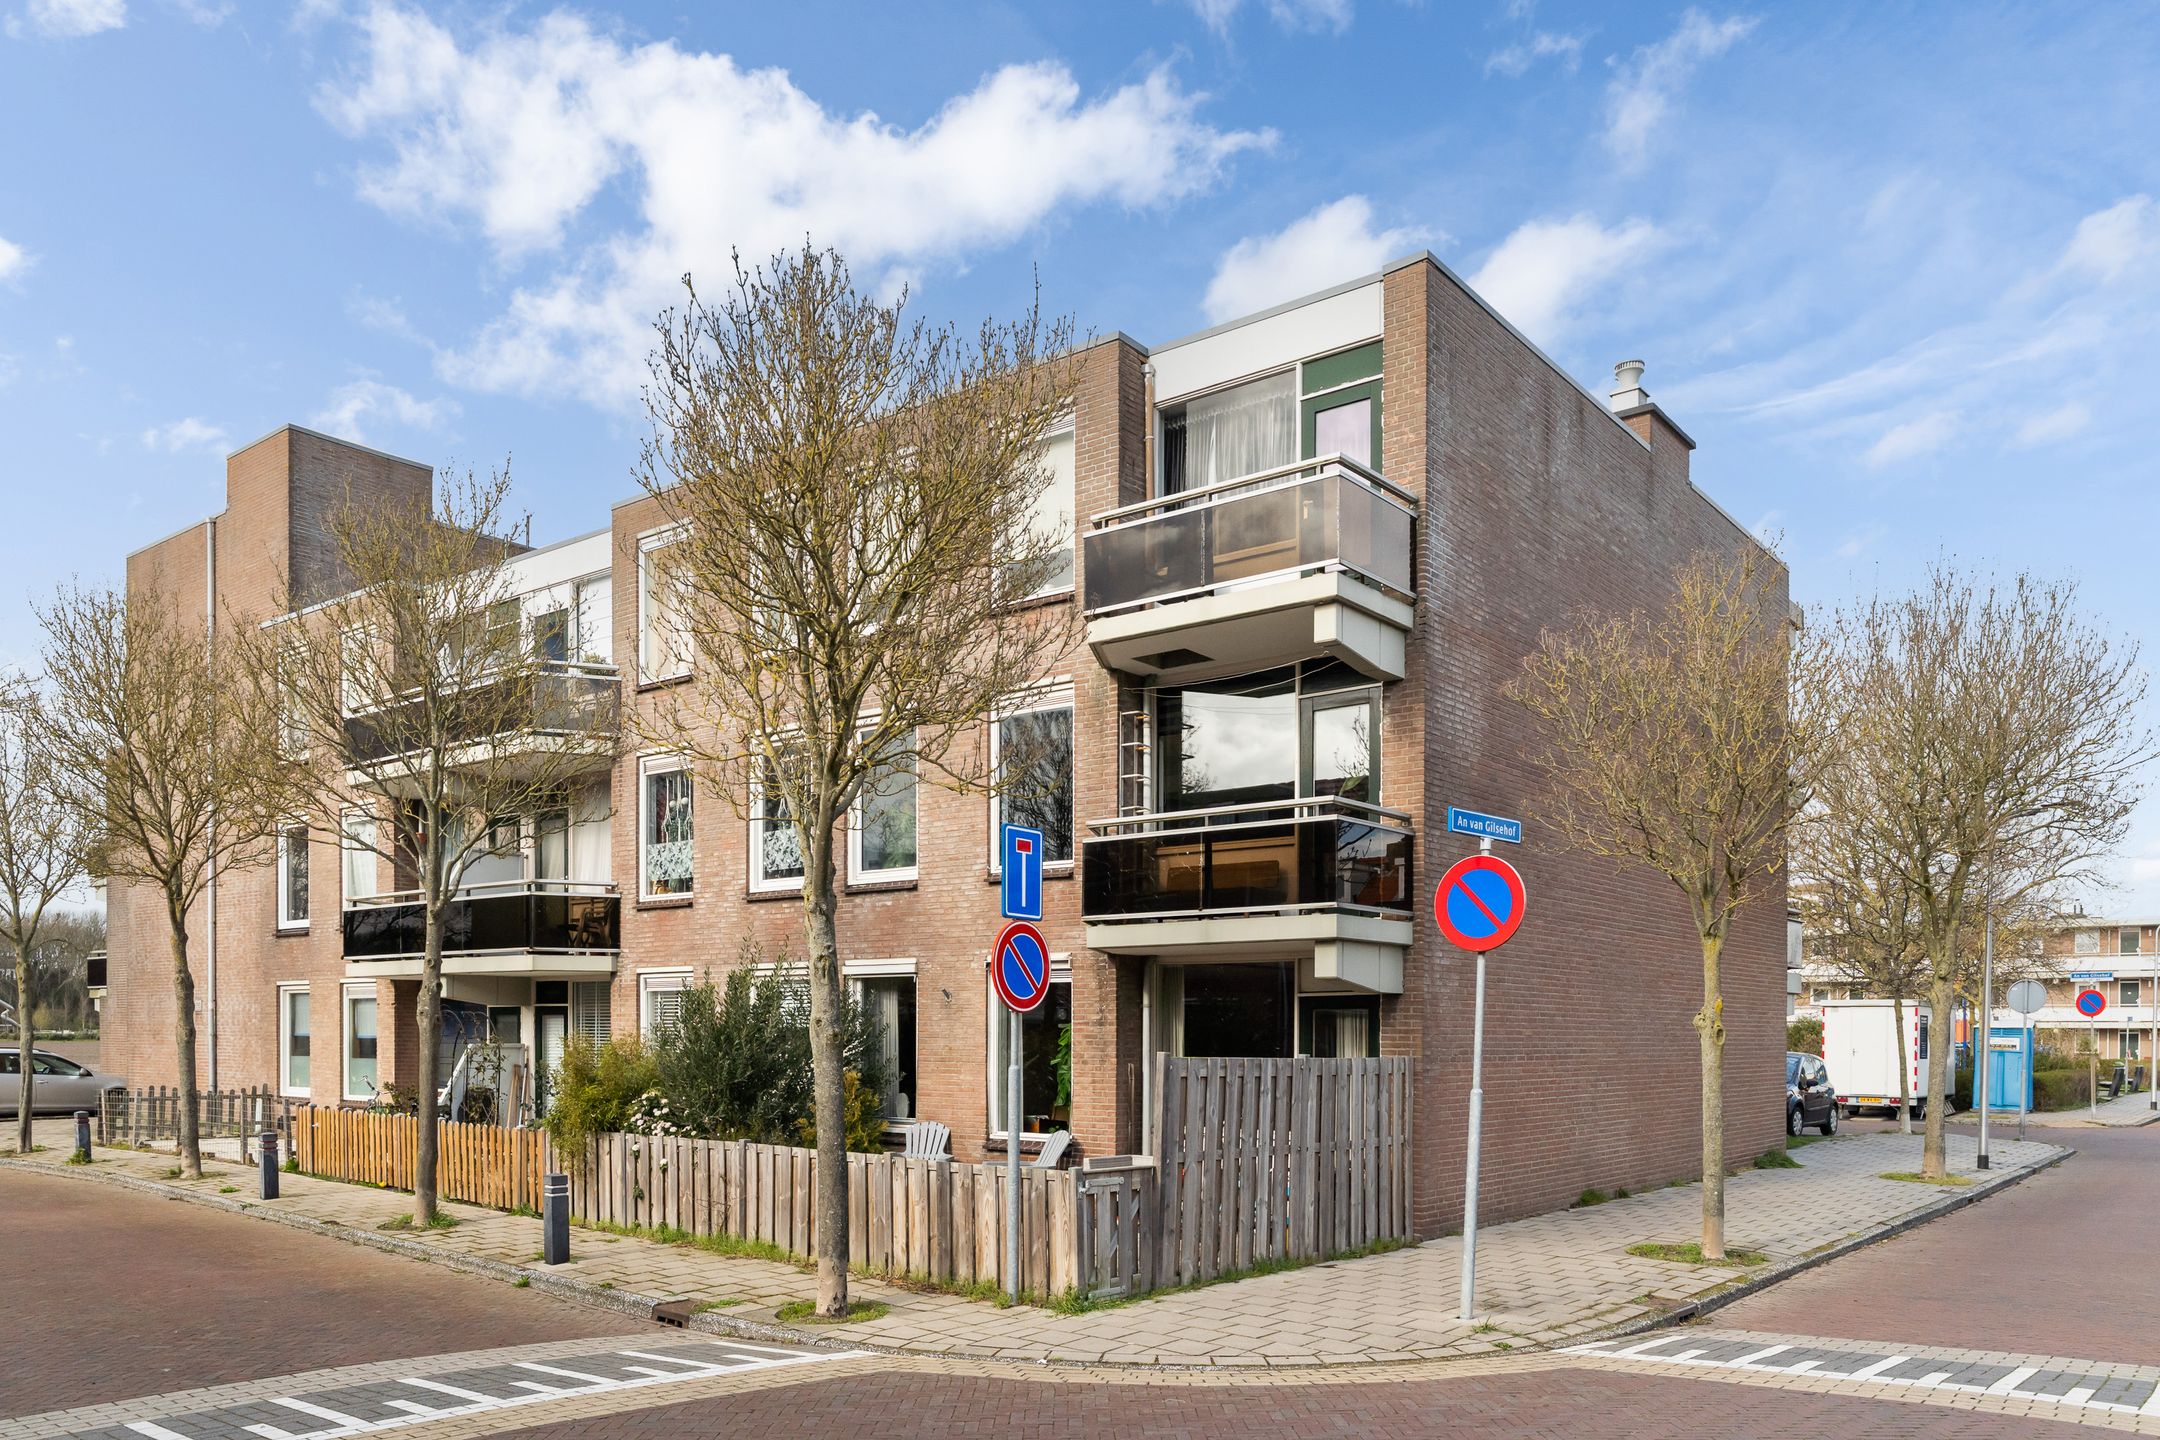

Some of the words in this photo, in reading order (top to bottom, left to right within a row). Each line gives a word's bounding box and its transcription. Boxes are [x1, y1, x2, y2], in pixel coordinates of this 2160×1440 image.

[1457, 815, 1468, 827] An
[1470, 819, 1483, 830] van
[1485, 821, 1516, 837] Gilsehof
